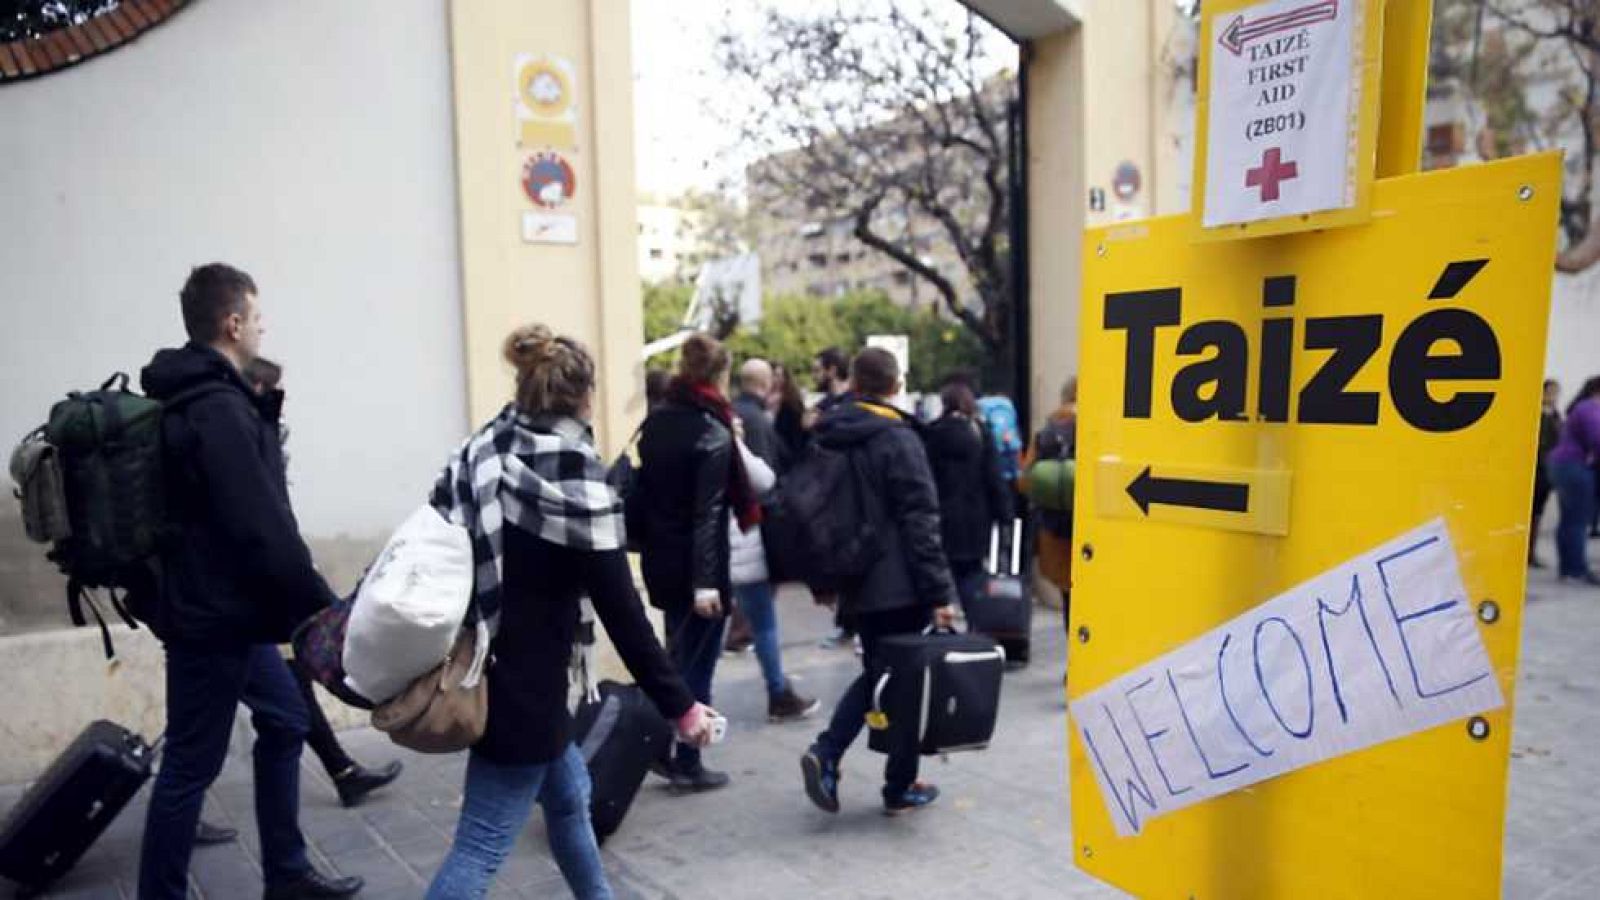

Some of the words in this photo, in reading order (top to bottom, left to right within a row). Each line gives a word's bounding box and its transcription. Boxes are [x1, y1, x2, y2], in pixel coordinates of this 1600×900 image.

[1246, 28, 1311, 62] TAIZÉ
[1248, 55, 1310, 85] FIRST
[1256, 84, 1296, 107] AID
[1245, 110, 1306, 141] (ZB01)
[1104, 259, 1502, 433] Taizé
[1084, 536, 1490, 832] WELCOME
